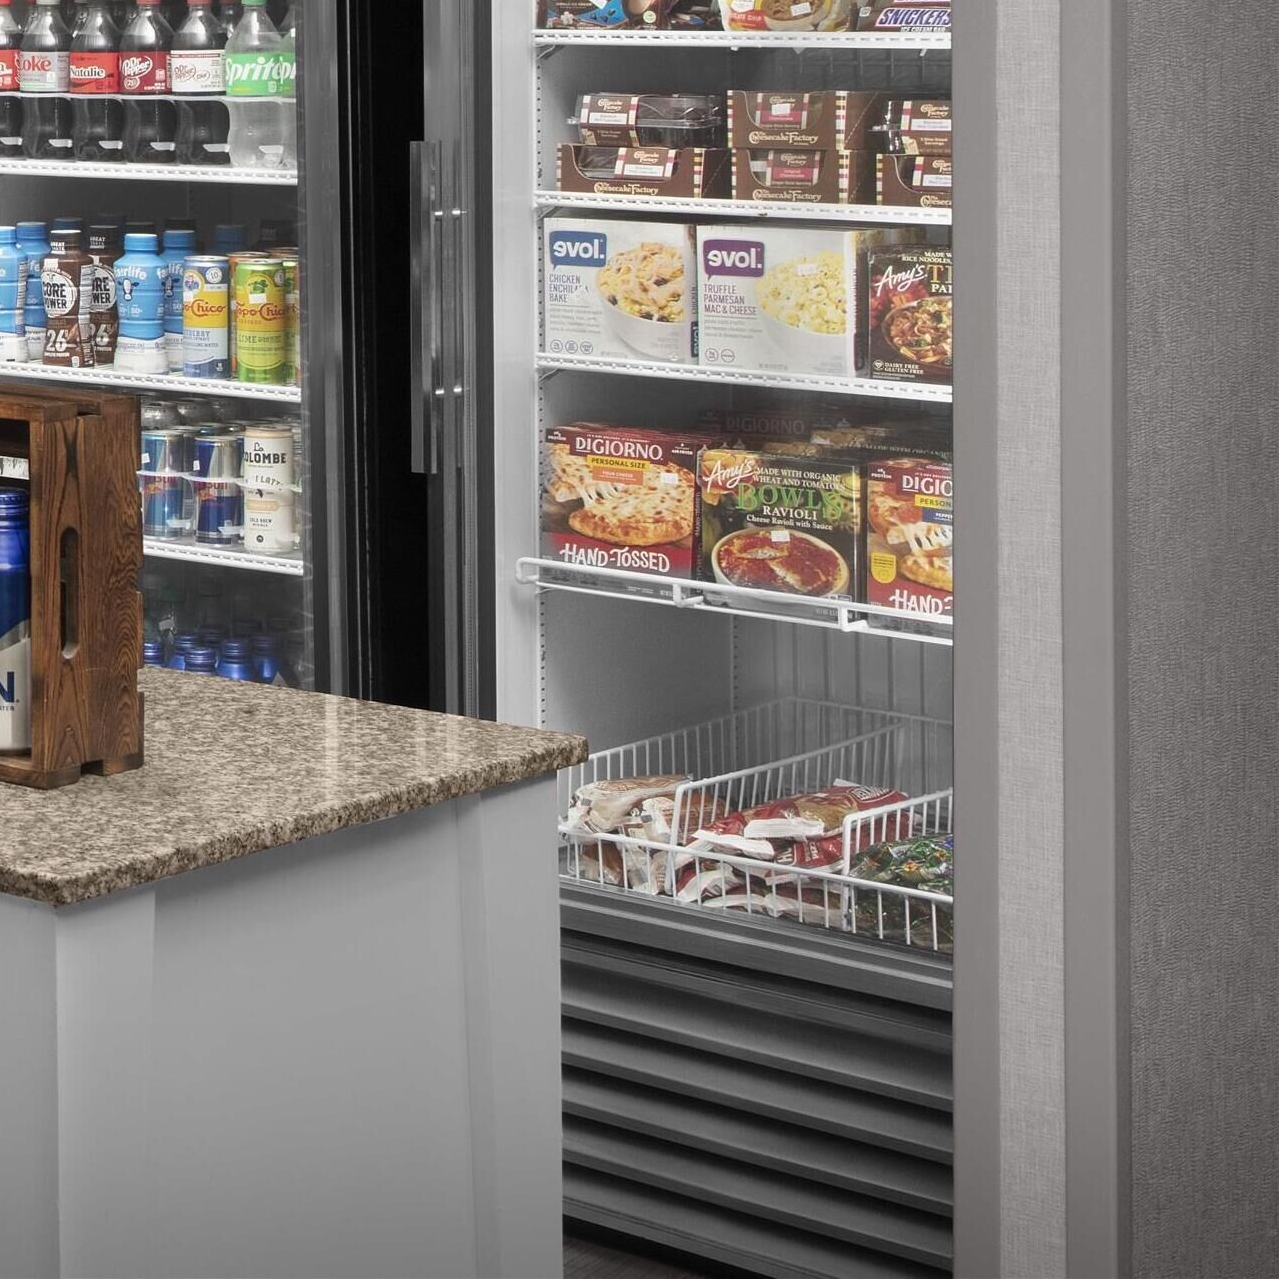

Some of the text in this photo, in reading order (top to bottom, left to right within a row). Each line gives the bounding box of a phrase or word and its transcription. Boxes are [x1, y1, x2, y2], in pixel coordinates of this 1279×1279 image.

[875, 8, 951, 27] SNICKERS
[70, 65, 106, 79] Natalie
[549, 273, 581, 284] CHICKEN
[874, 264, 927, 297] Amy's
[704, 284, 737, 295] TRUFFLE
[549, 293, 568, 303] BAKE
[704, 294, 746, 305] PARMESAN
[192, 299, 226, 317] Chico
[704, 304, 721, 314] MAC
[729, 306, 758, 316] CHEESE
[591, 457, 646, 469] PERSONAL SIZE
[703, 458, 755, 494] Amy's
[753, 475, 781, 485] WHEAT
[782, 478, 799, 487] AND
[757, 466, 841, 482] MADE WITH ORGANIC
[902, 475, 953, 497] DIGIO
[735, 482, 842, 521] BOWLS
[919, 497, 952, 507] PERSON
[762, 505, 818, 521] RAVIOLI
[746, 513, 834, 531] Cheese Ravioli with Sauce
[559, 543, 670, 573] HAND-TOSSED
